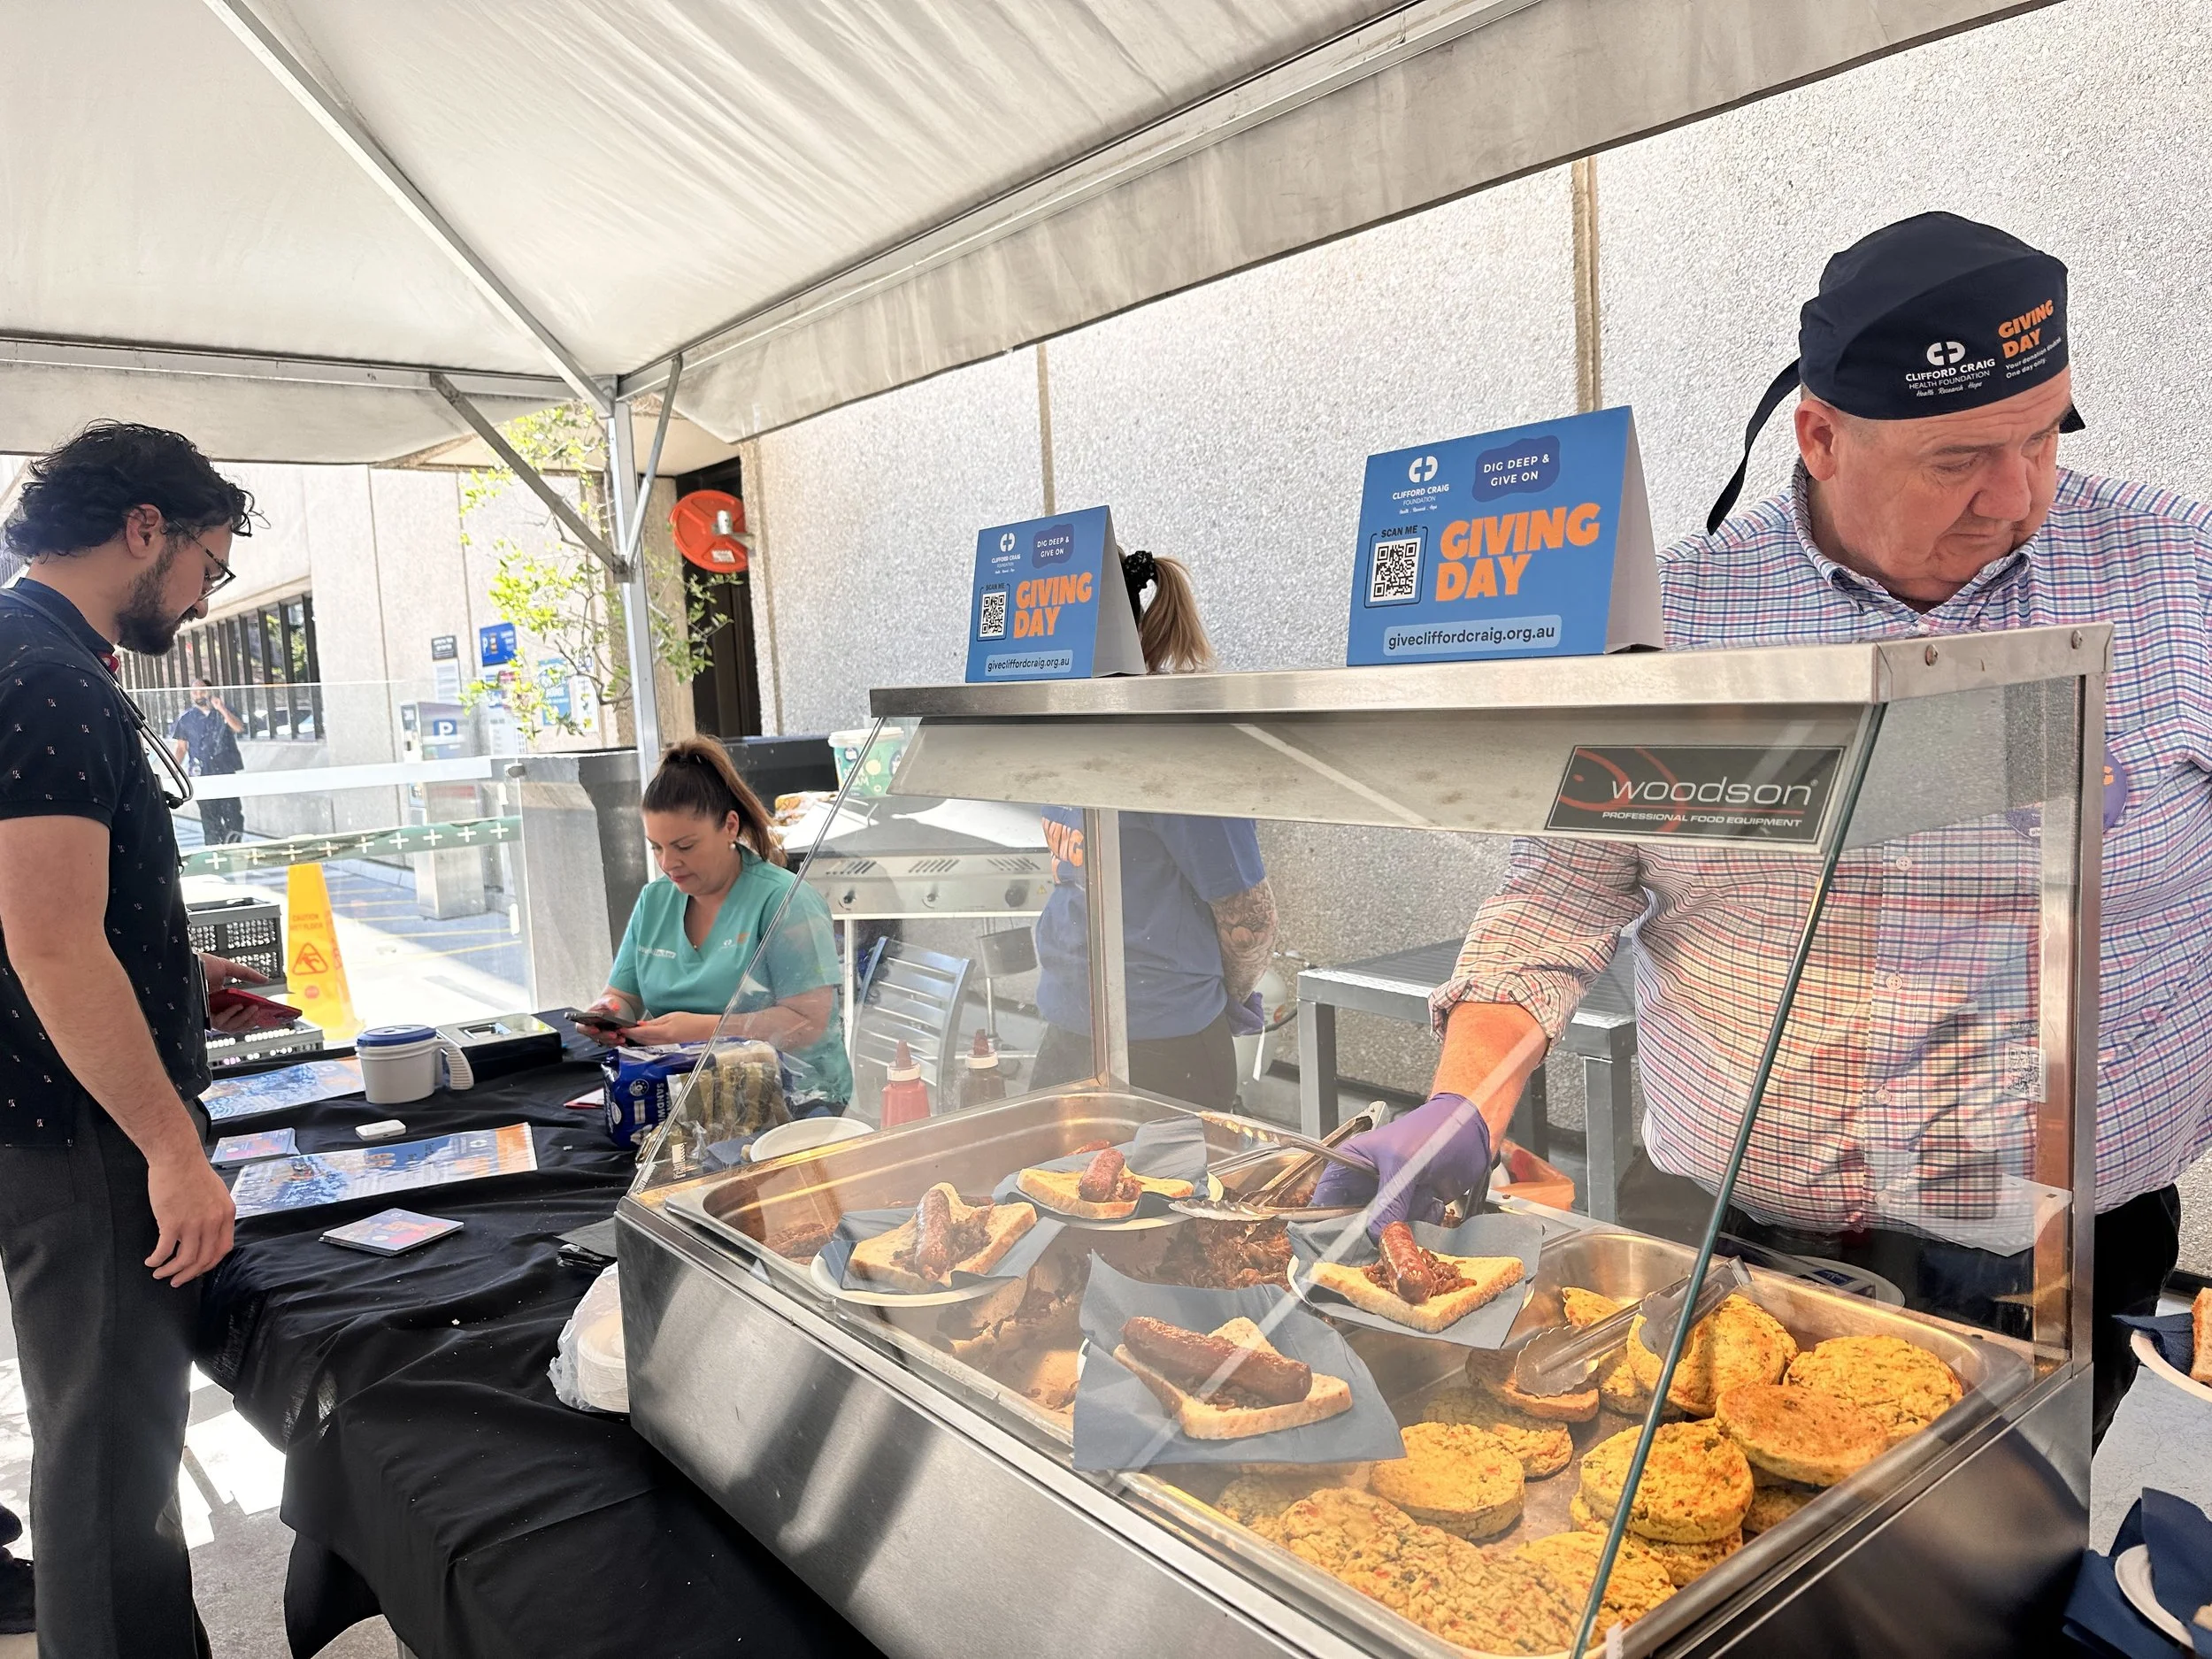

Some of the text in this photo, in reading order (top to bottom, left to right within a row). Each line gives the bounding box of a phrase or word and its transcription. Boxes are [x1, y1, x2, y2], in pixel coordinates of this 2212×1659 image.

[1998, 299, 2054, 339] GIVING
[2002, 328, 2041, 358] DAY
[2006, 361, 2022, 371] Your
[2022, 347, 2047, 365] donation
[1905, 358, 1996, 382] CLIFFORD CRAIG
[1909, 370, 1990, 390] HEALTH FOUNDATION
[2006, 370, 2021, 379] One
[2022, 365, 2033, 376] day
[1483, 453, 1550, 473] DIG DEEP &
[1490, 470, 1539, 487] GIVE ON
[1392, 484, 1450, 501] CLIFFORD CRAIG
[1402, 495, 1436, 506] FOUNDATION
[1048, 537, 1064, 546] DEEP
[1380, 526, 1417, 538] SCAN ME
[1440, 503, 1601, 561] GIVING
[1435, 553, 1532, 602] DAY
[1016, 572, 1093, 609] GIVING
[1013, 606, 1061, 639] DAY
[1388, 626, 1555, 649] givecliffordcraig.org.au
[987, 657, 1070, 672] givecliffordcraig.org.au
[1611, 776, 1812, 806] woodson
[1602, 811, 1802, 827] PROFESSIONAL FOOD EQUIPMENT
